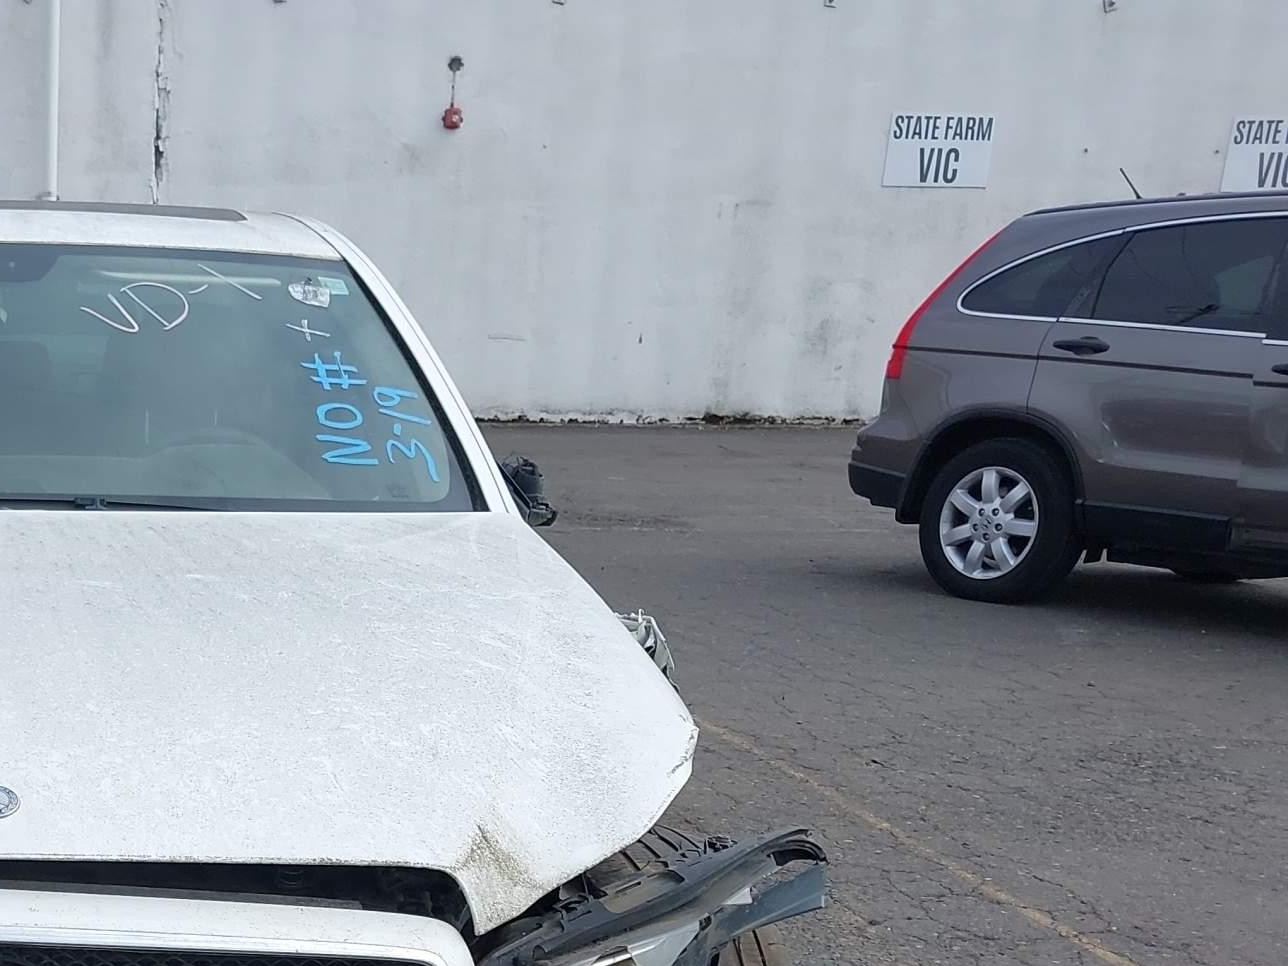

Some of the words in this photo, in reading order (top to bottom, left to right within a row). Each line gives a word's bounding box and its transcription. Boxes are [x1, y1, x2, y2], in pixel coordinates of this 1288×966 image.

[893, 115, 942, 140] STATE
[944, 116, 995, 141] FARM
[1233, 119, 1285, 145] STATE
[919, 147, 961, 184] VIC
